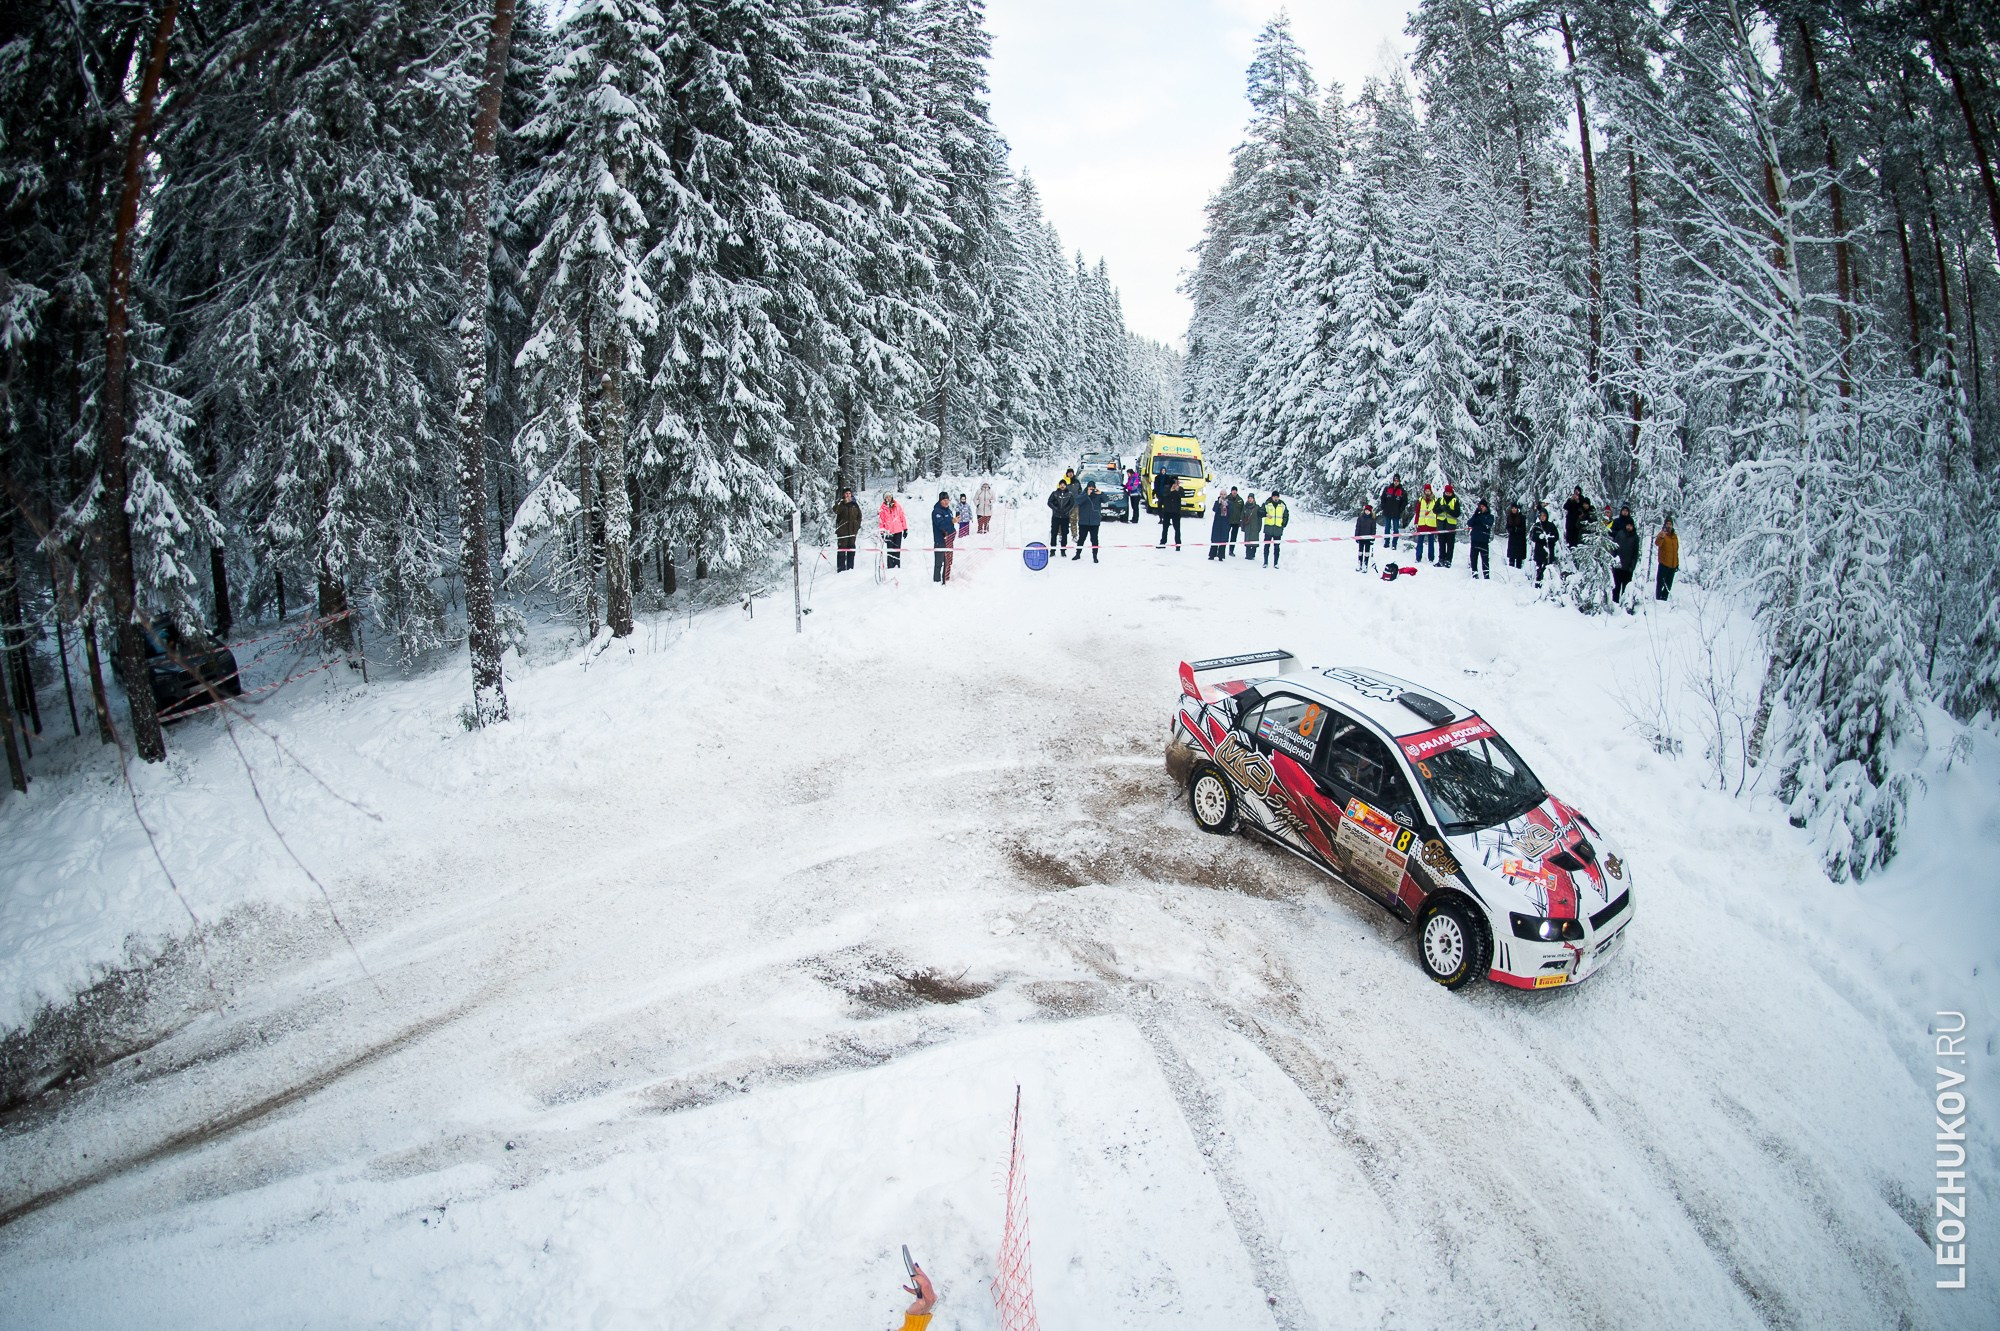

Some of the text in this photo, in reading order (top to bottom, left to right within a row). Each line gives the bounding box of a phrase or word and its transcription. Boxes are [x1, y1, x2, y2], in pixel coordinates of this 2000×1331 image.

[1299, 703, 1321, 737] 8
[1268, 730, 1311, 761] Балащенко
[1272, 720, 1315, 750] Балащенко
[1418, 734, 1453, 752] РАЛЛИ
[1451, 725, 1484, 739] РОССИИ
[1417, 762, 1432, 779] 8
[1379, 826, 1393, 841] 24
[1397, 830, 1411, 851] 8
[1430, 847, 1459, 874] Rally
